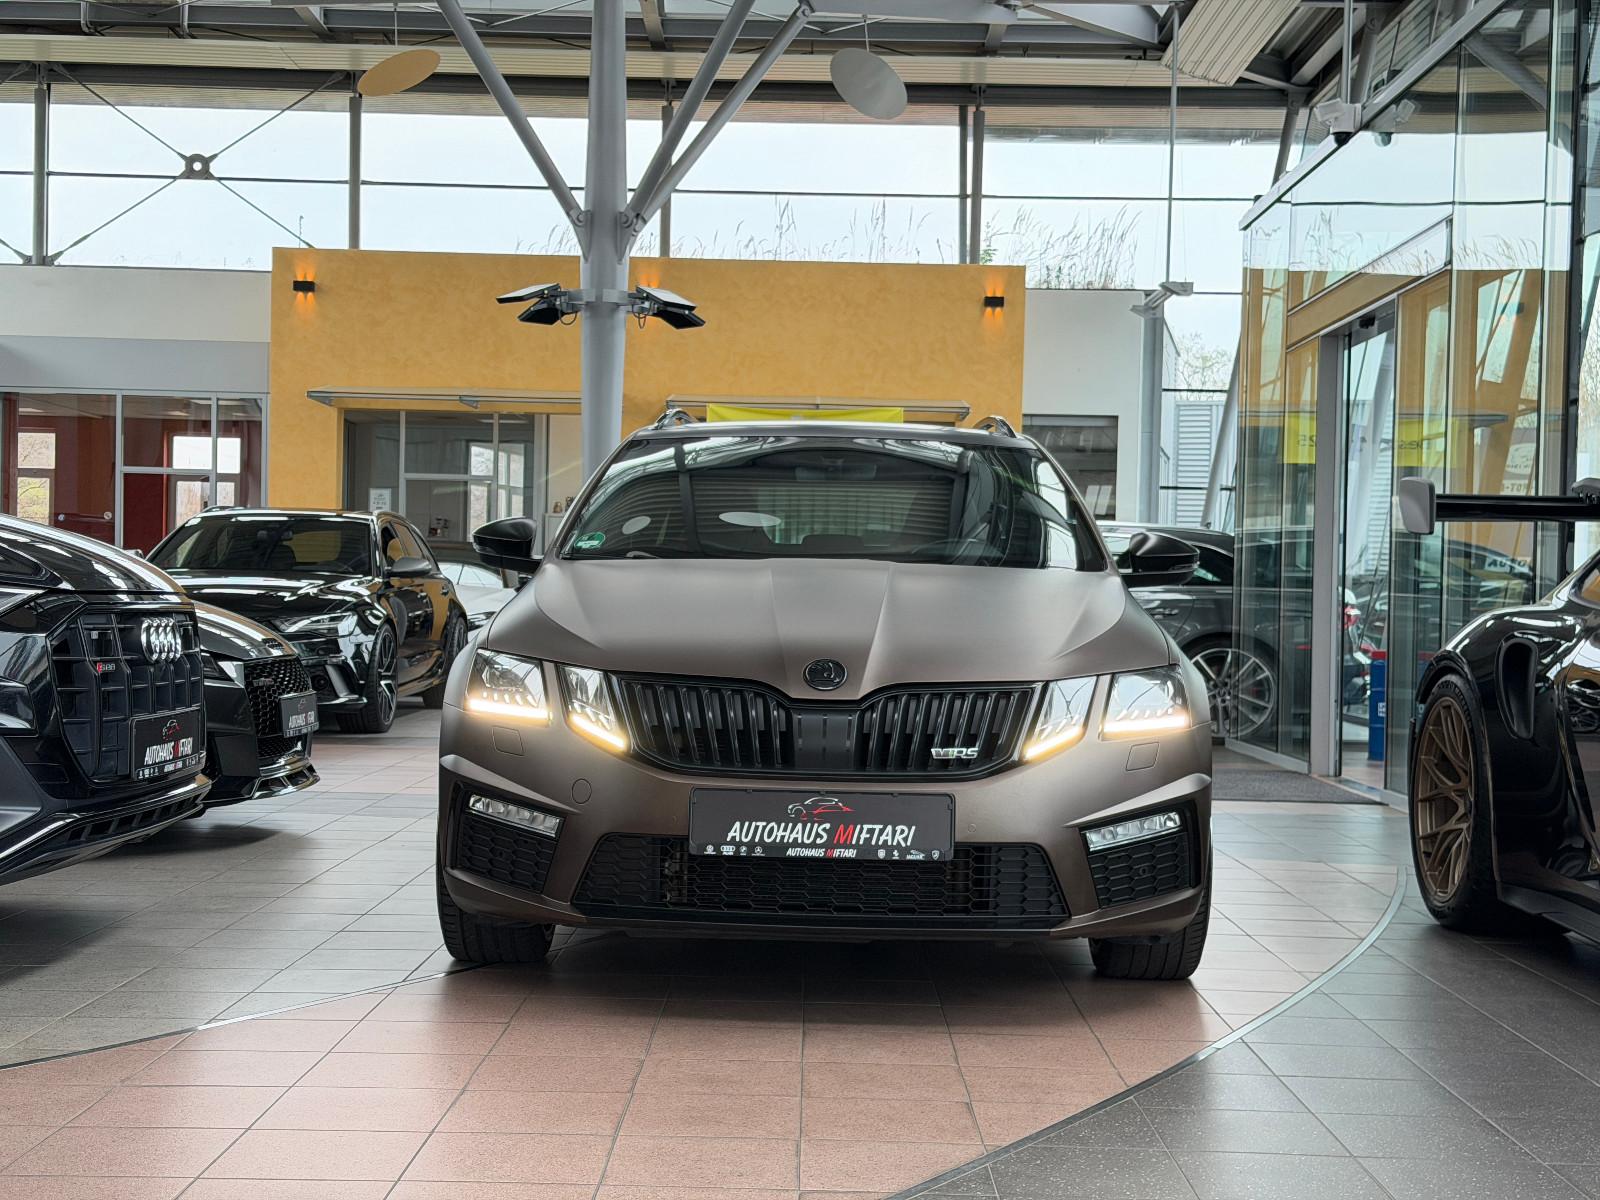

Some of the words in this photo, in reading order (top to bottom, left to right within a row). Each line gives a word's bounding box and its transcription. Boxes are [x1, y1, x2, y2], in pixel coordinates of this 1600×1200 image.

[144, 741, 174, 766] AUTOHAUS
[726, 821, 830, 844] AUTOHAUS
[833, 823, 916, 847] MIFTARI
[786, 847, 825, 857] AUTOHAUS
[826, 848, 857, 858] MIFTARI
